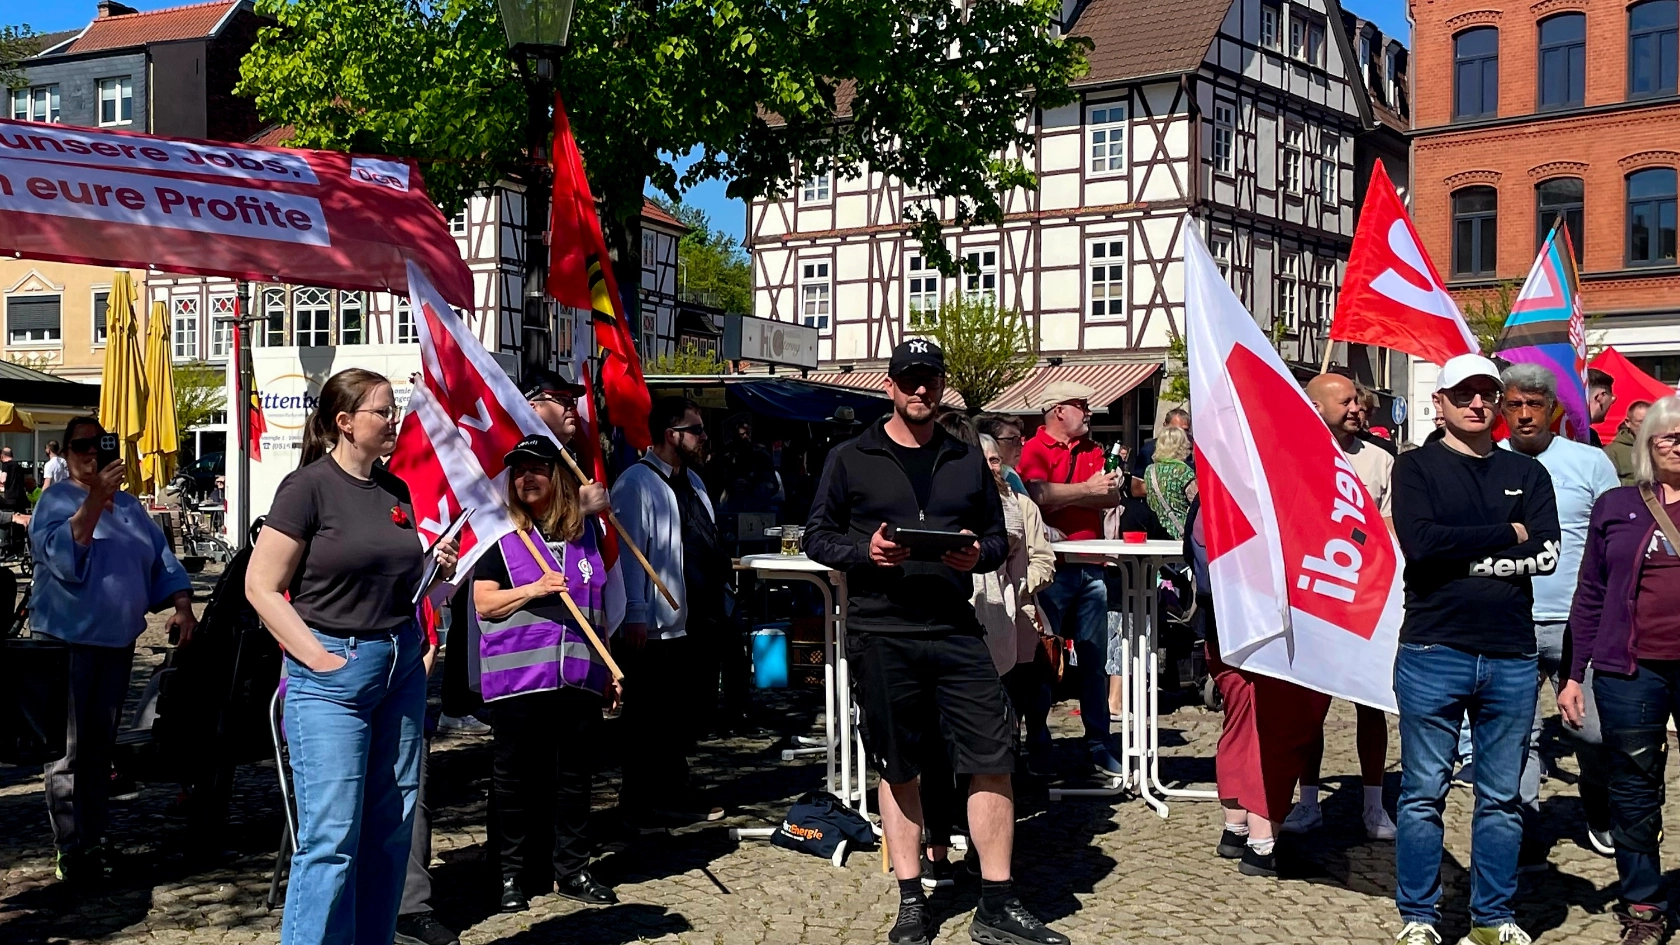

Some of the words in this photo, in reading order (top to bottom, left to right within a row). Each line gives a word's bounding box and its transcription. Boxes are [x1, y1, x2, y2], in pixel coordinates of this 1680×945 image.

[0, 132, 170, 162] unsere
[181, 151, 301, 178] Jobs,
[26, 176, 146, 211] eure
[153, 186, 313, 231] Profite
[1468, 539, 1561, 577] Bench
